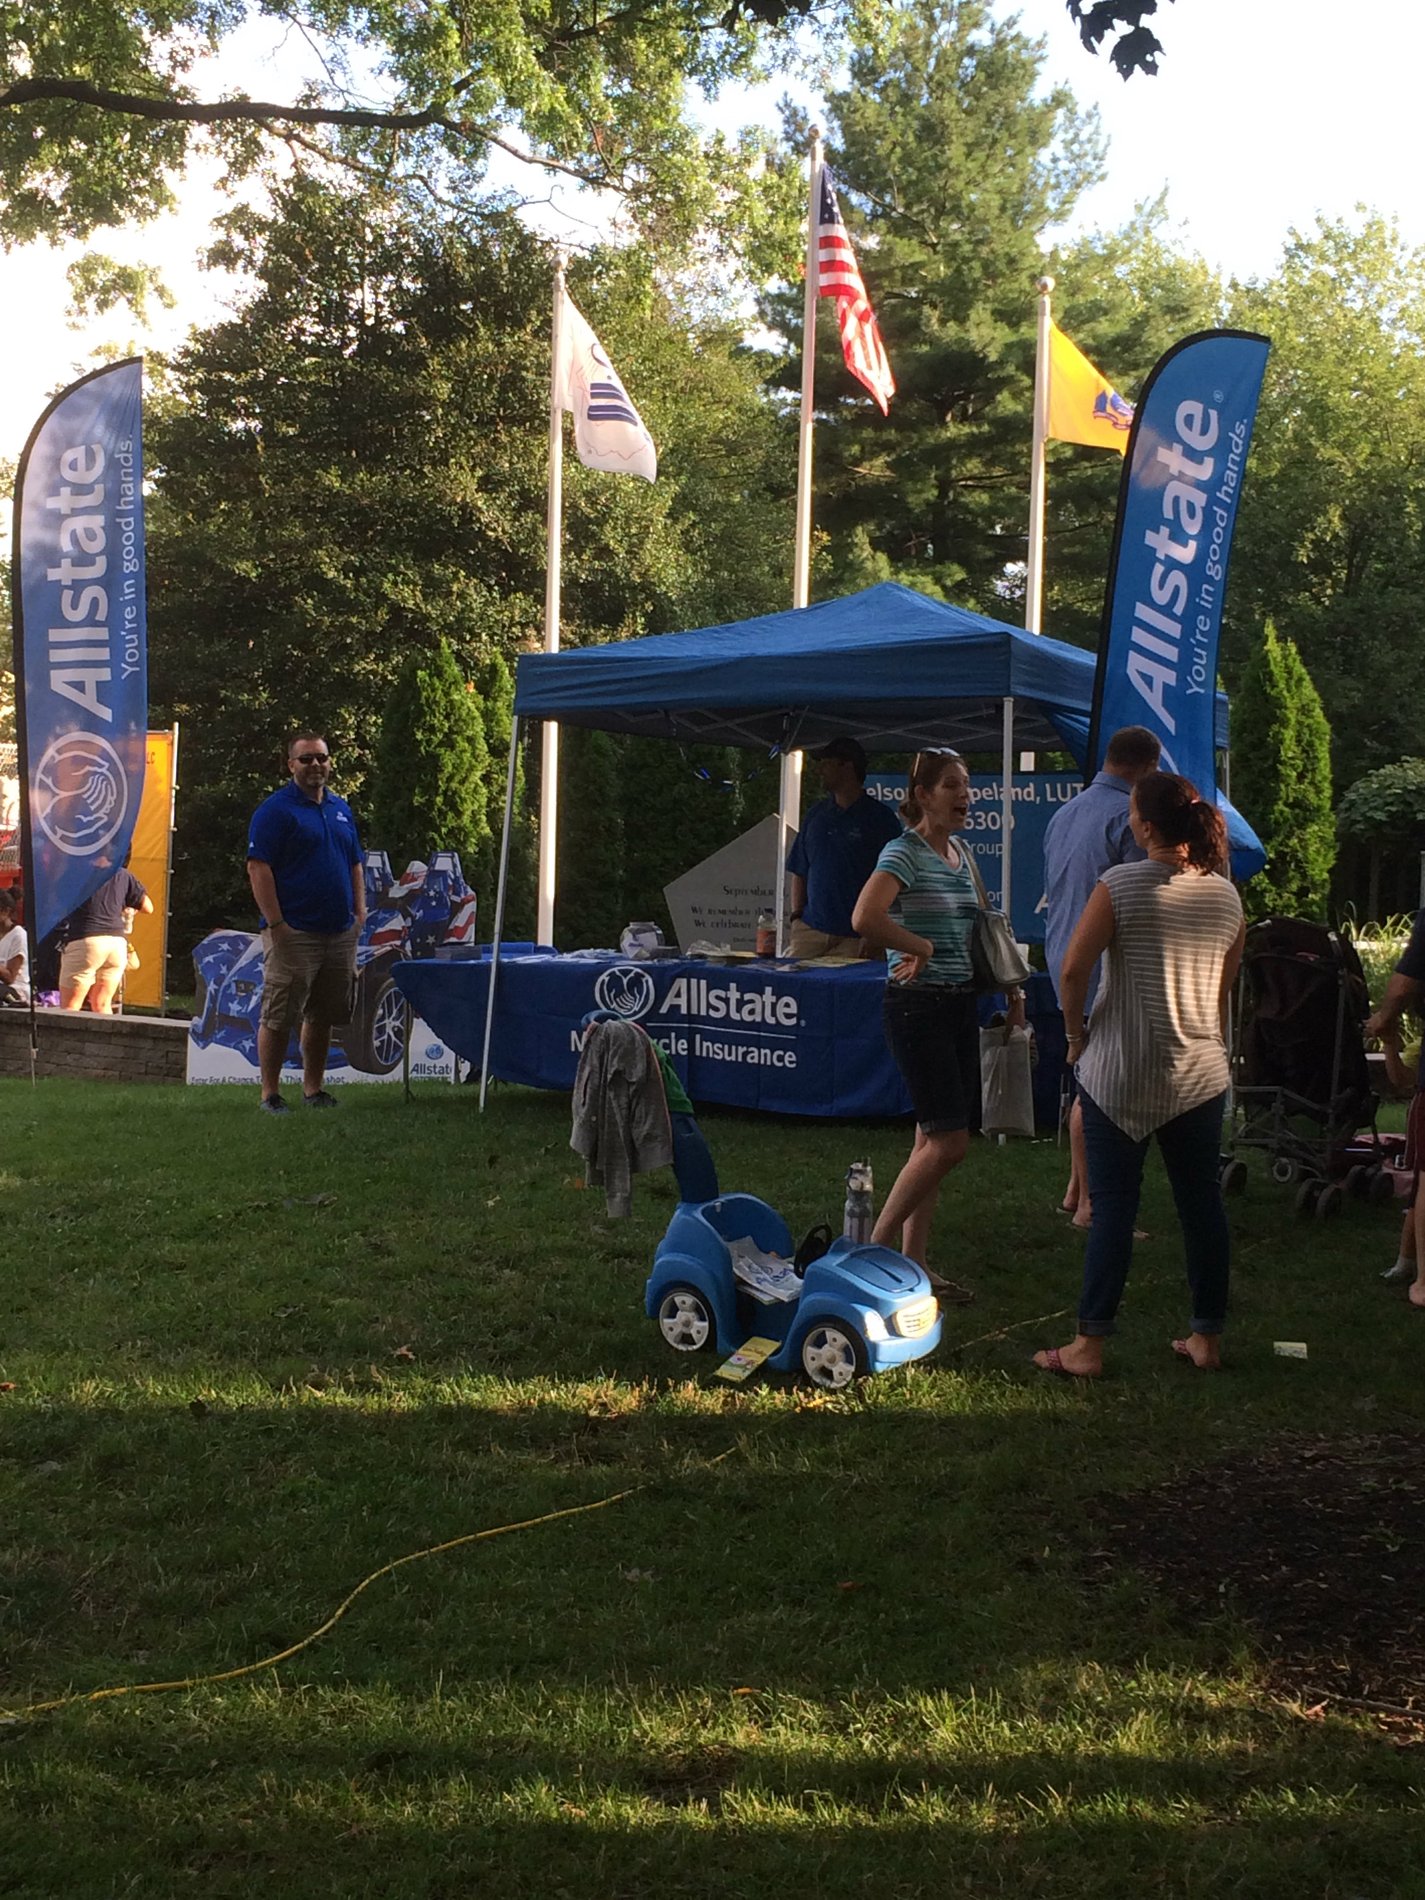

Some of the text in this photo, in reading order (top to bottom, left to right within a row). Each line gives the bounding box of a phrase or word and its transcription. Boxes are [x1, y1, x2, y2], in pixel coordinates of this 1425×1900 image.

[46, 443, 113, 723] Allstate
[114, 434, 140, 680] You're in good hands.
[1126, 400, 1219, 736] Allstate
[1185, 419, 1247, 695] You're in good hands.
[410, 1063, 452, 1075] Allstat
[659, 977, 798, 1027] Allstate
[695, 1033, 797, 1068] Insurance
